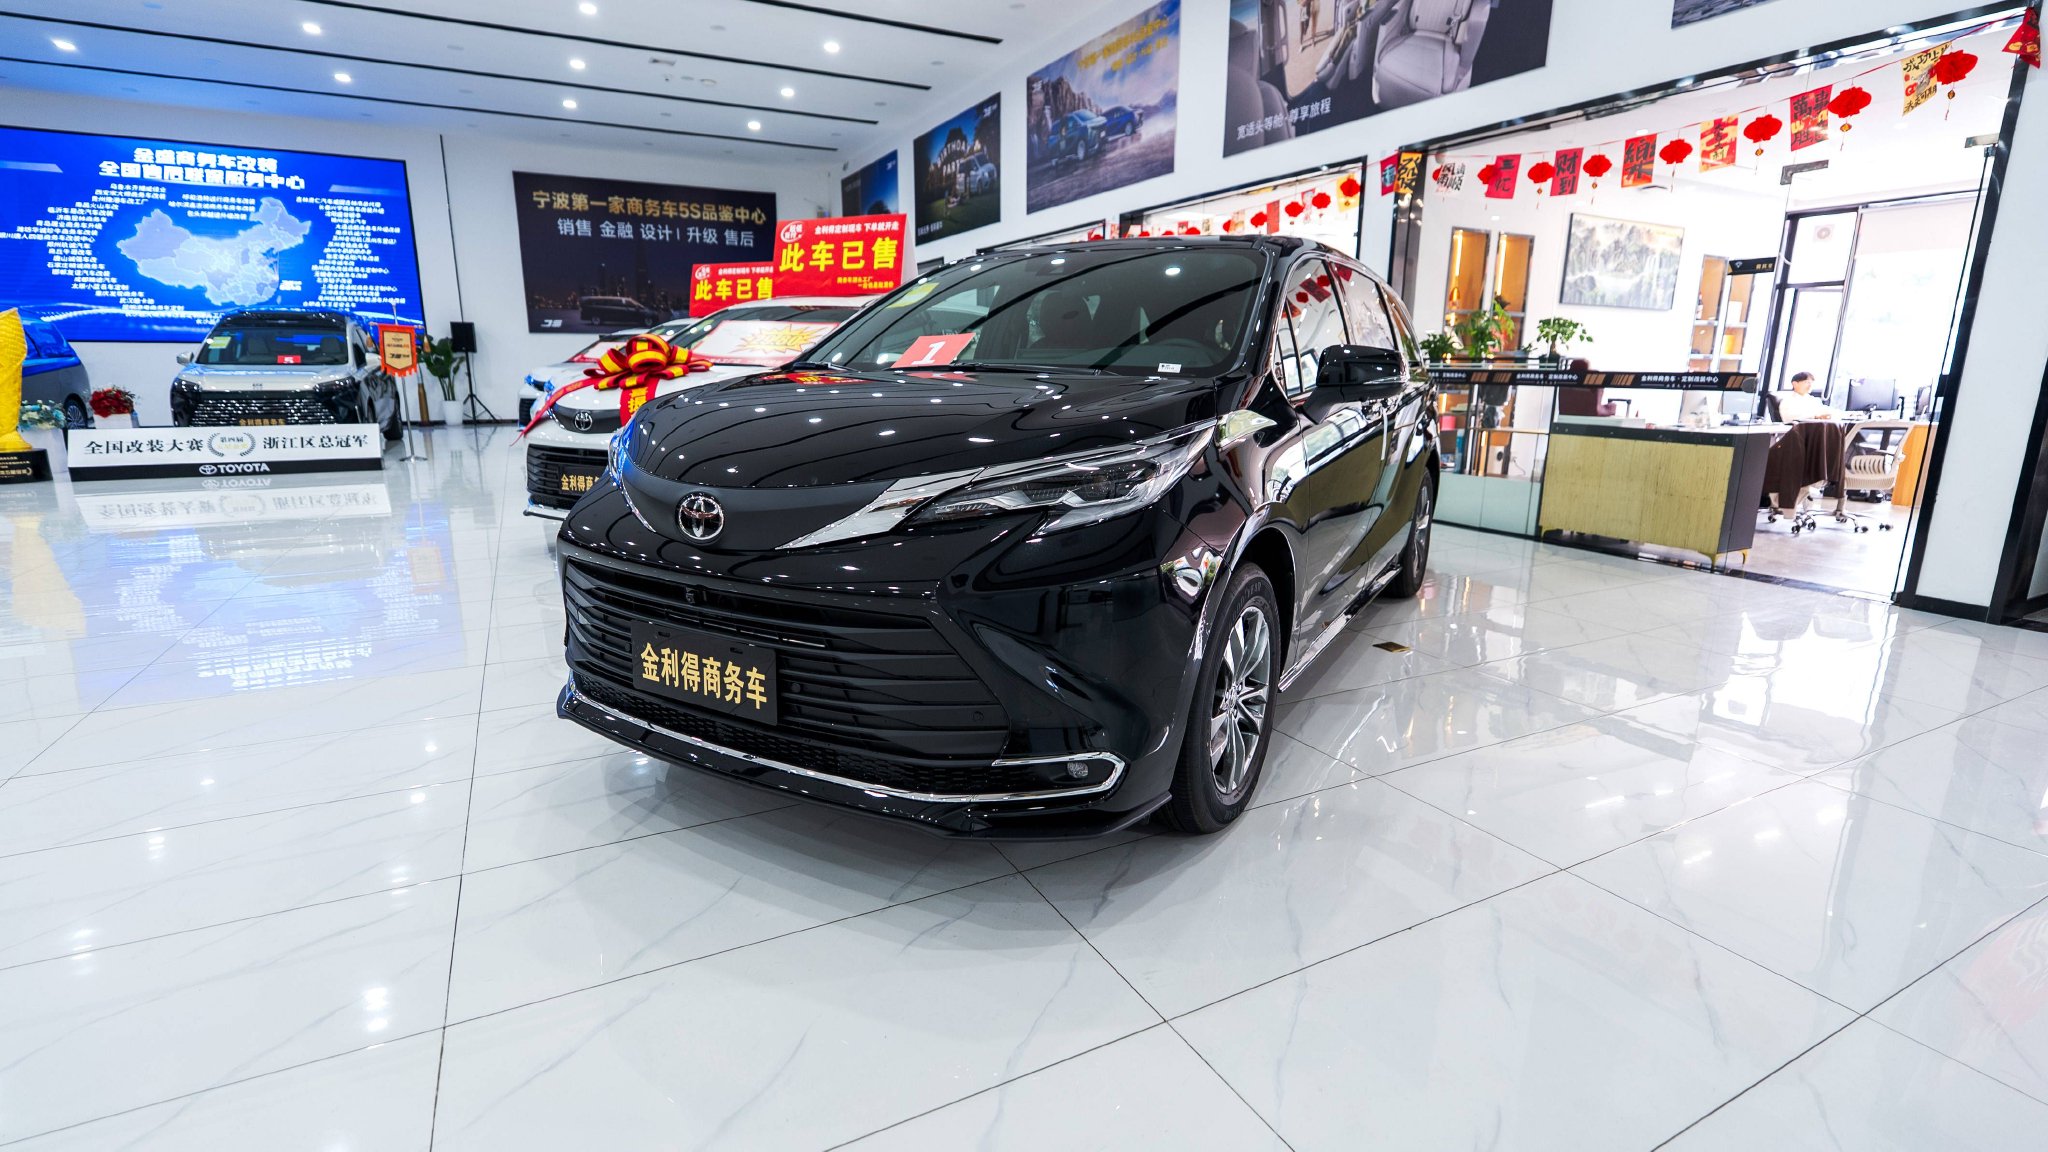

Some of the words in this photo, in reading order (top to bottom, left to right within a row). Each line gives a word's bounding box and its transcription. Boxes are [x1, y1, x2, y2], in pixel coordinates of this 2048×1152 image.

[532, 190, 766, 225] 宁波第一家商务车5S品鉴中心
[557, 217, 592, 236] 销售
[600, 221, 633, 239] 金融
[640, 223, 672, 241] 设计
[687, 226, 718, 244] 升级
[724, 229, 754, 247] 售后
[779, 236, 898, 272] 此车已售
[695, 277, 773, 301] 此车已售
[911, 341, 946, 367] 1
[84, 439, 204, 455] 全国改装大赛
[263, 434, 368, 449] 浙江区总冠军
[217, 463, 270, 473] TOYOTA
[640, 643, 768, 710] 金利得商务车
